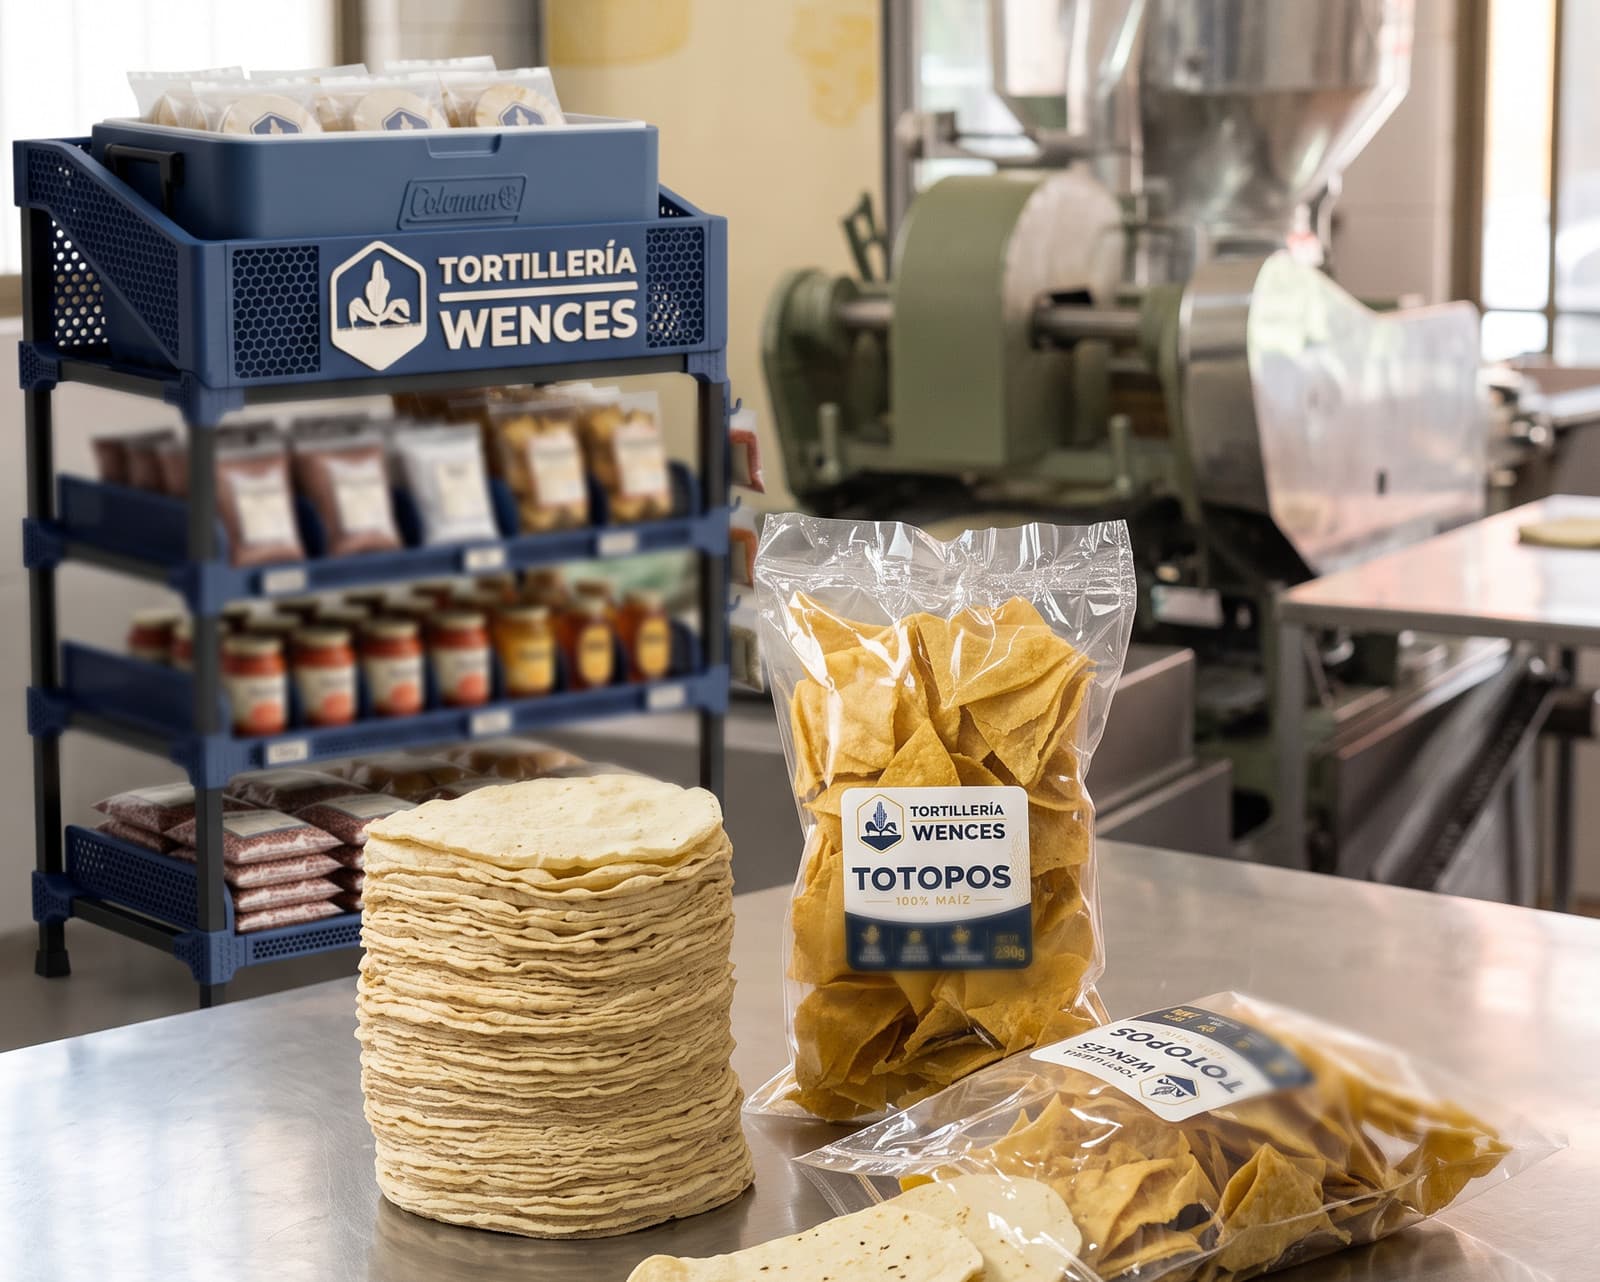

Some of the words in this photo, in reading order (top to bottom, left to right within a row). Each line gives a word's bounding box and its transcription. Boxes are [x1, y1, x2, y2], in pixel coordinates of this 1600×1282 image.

[438, 240, 637, 285] TORTILLERÍA
[439, 299, 638, 350] WENCES
[910, 801, 1004, 817] TORTILLERÍA
[912, 823, 1006, 841] WENCES
[852, 865, 1012, 891] TOTOPOS
[895, 896, 929, 906] 100%
[1077, 1042, 1156, 1073] WENCES
[1109, 1027, 1243, 1094] TOTOPOS
